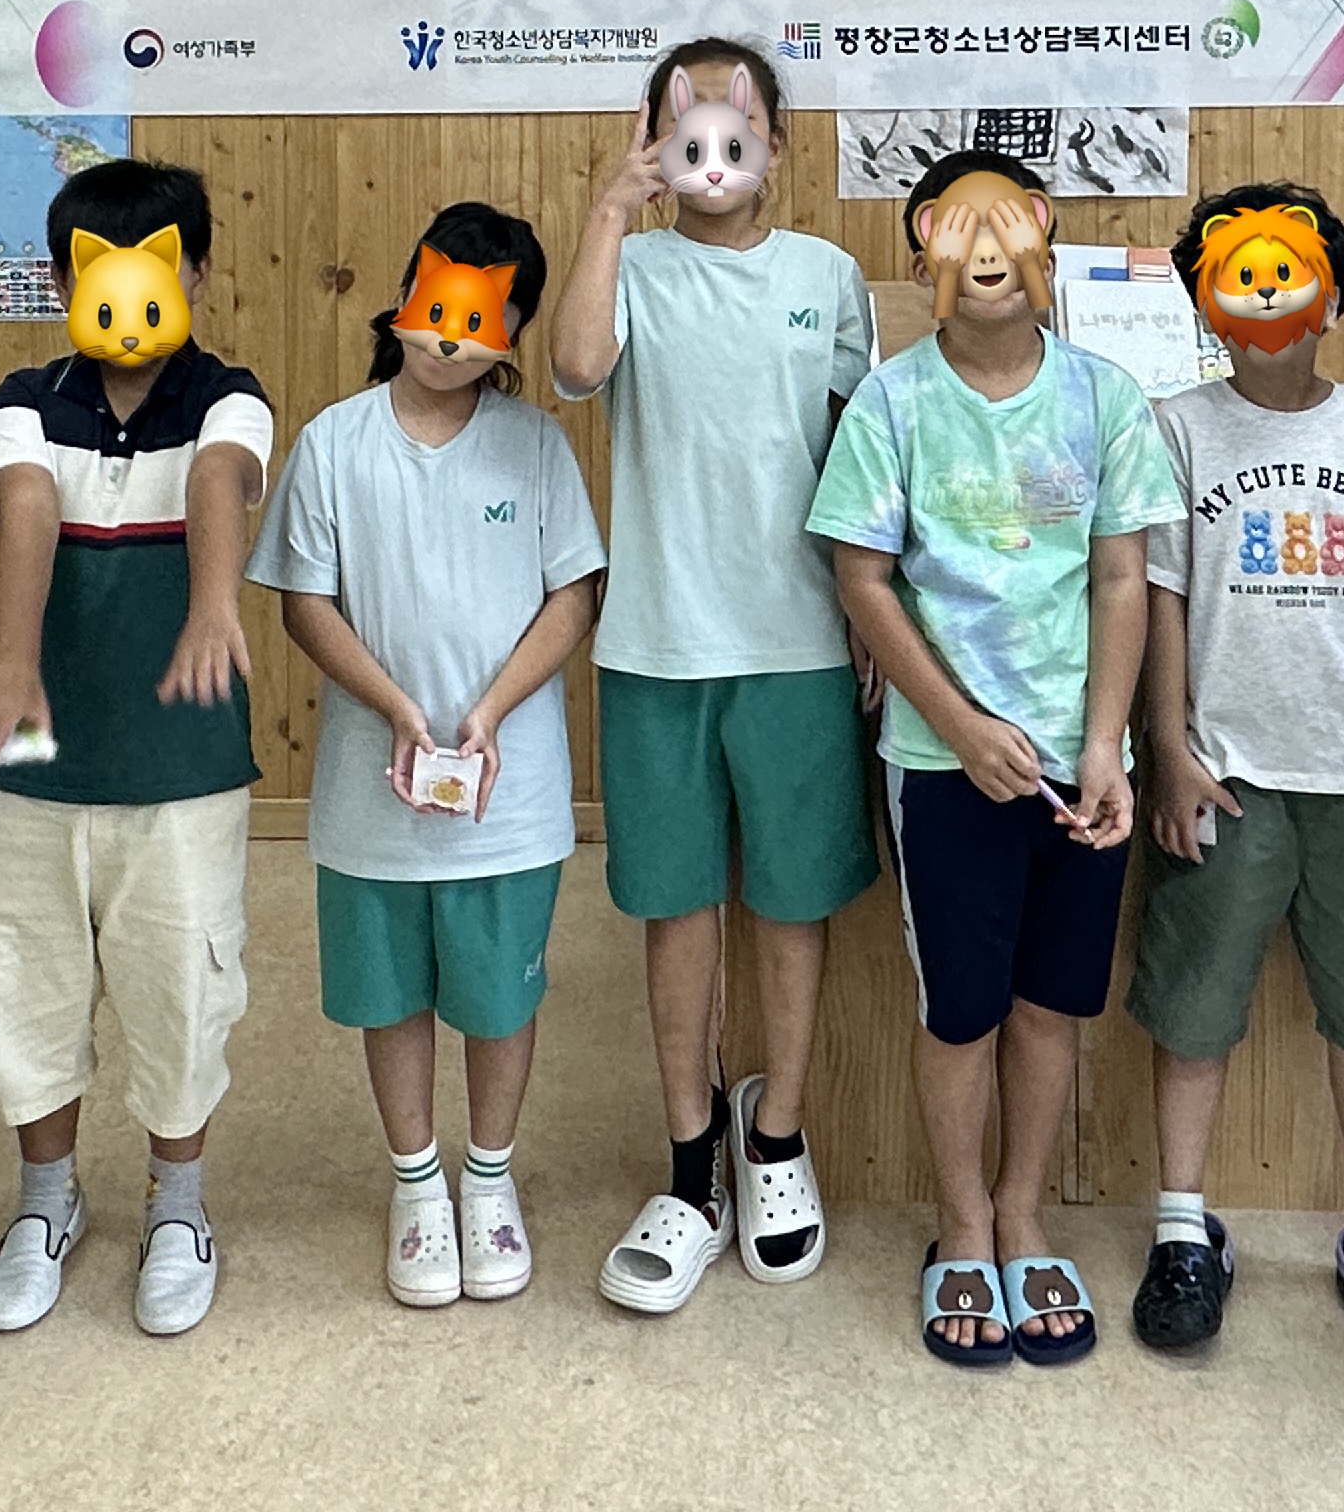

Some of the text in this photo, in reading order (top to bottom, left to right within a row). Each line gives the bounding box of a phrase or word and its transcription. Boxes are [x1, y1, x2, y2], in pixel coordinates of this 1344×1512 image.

[172, 40, 256, 59] 여성가족부
[455, 27, 658, 50] 한국청소년상담복지개발원
[834, 24, 1190, 55] 평창군청소년상담복지센터
[1195, 484, 1232, 524] MY
[1236, 464, 1306, 494] CUTE
